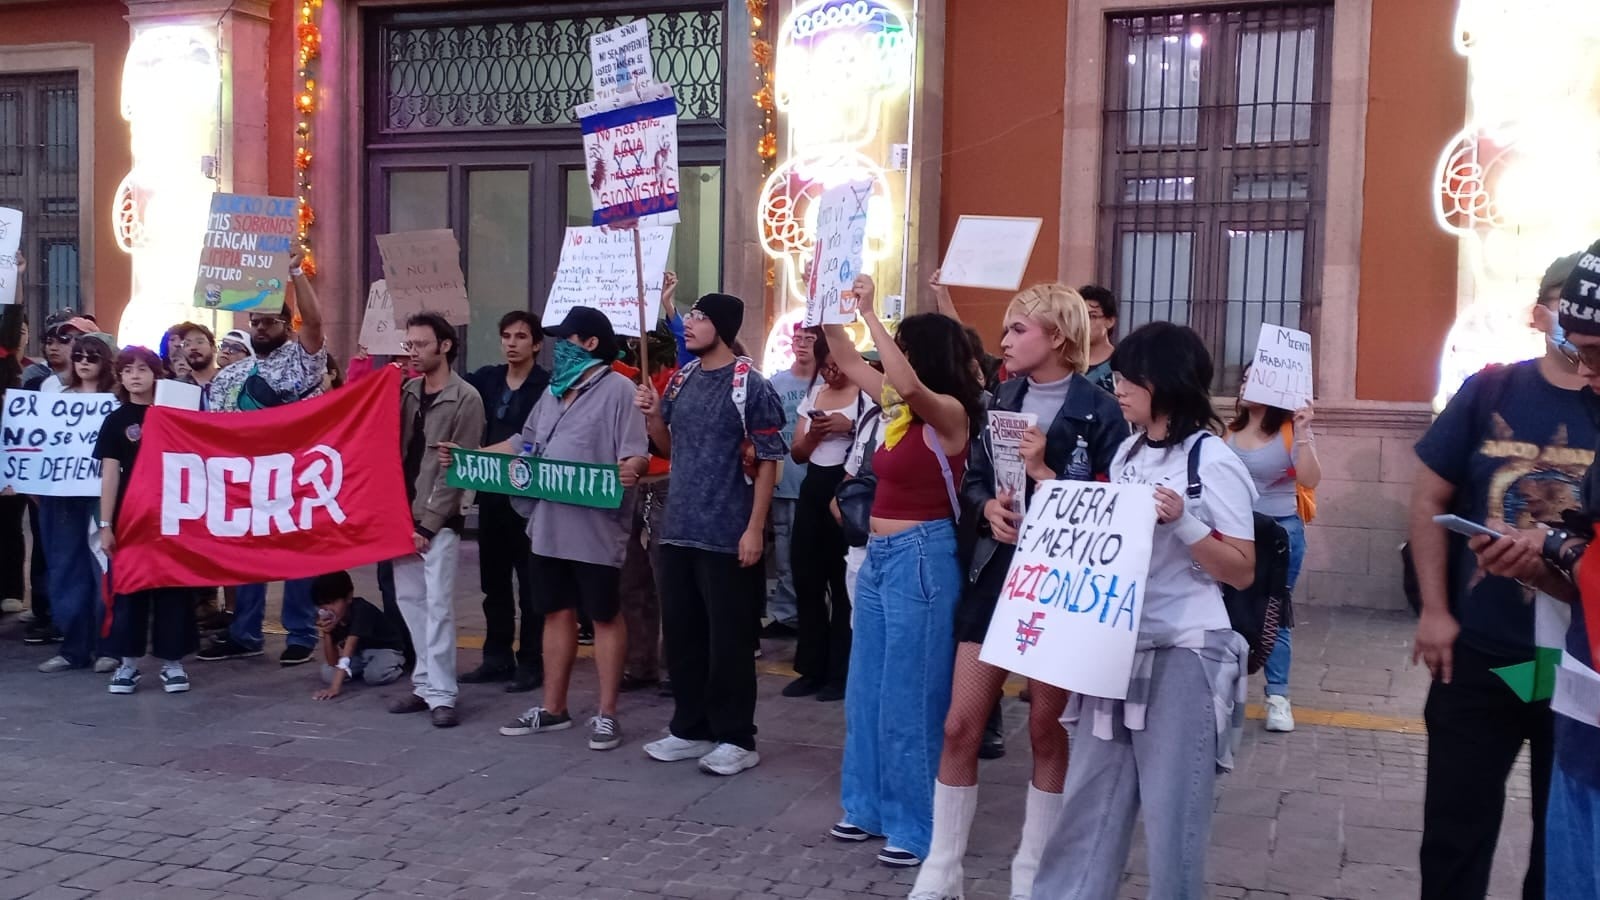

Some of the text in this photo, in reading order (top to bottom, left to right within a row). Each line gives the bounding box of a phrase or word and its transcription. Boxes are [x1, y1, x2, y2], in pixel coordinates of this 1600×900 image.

[595, 65, 612, 76] USTED
[637, 54, 643, 63] SE
[596, 117, 660, 143] No nos falta
[600, 177, 678, 217] SIONISTAS
[207, 213, 296, 234] MIS SOBRINOS
[205, 231, 258, 251] TENGAN
[568, 231, 582, 246] No
[584, 235, 592, 244] a
[198, 265, 242, 281] FUTURO
[241, 254, 256, 267] EN
[257, 255, 273, 269] SU
[1277, 329, 1310, 353] MIENT
[1259, 348, 1304, 372] TRABAJAS
[1252, 368, 1277, 388] NO
[8, 394, 113, 427] el agua
[3, 426, 100, 446] NO se ve
[4, 456, 31, 481] SE
[454, 452, 617, 498] LEON ANTIFA
[160, 451, 299, 537] PCR
[1037, 486, 1119, 527] FUERA
[1030, 526, 1122, 567] MEXICO
